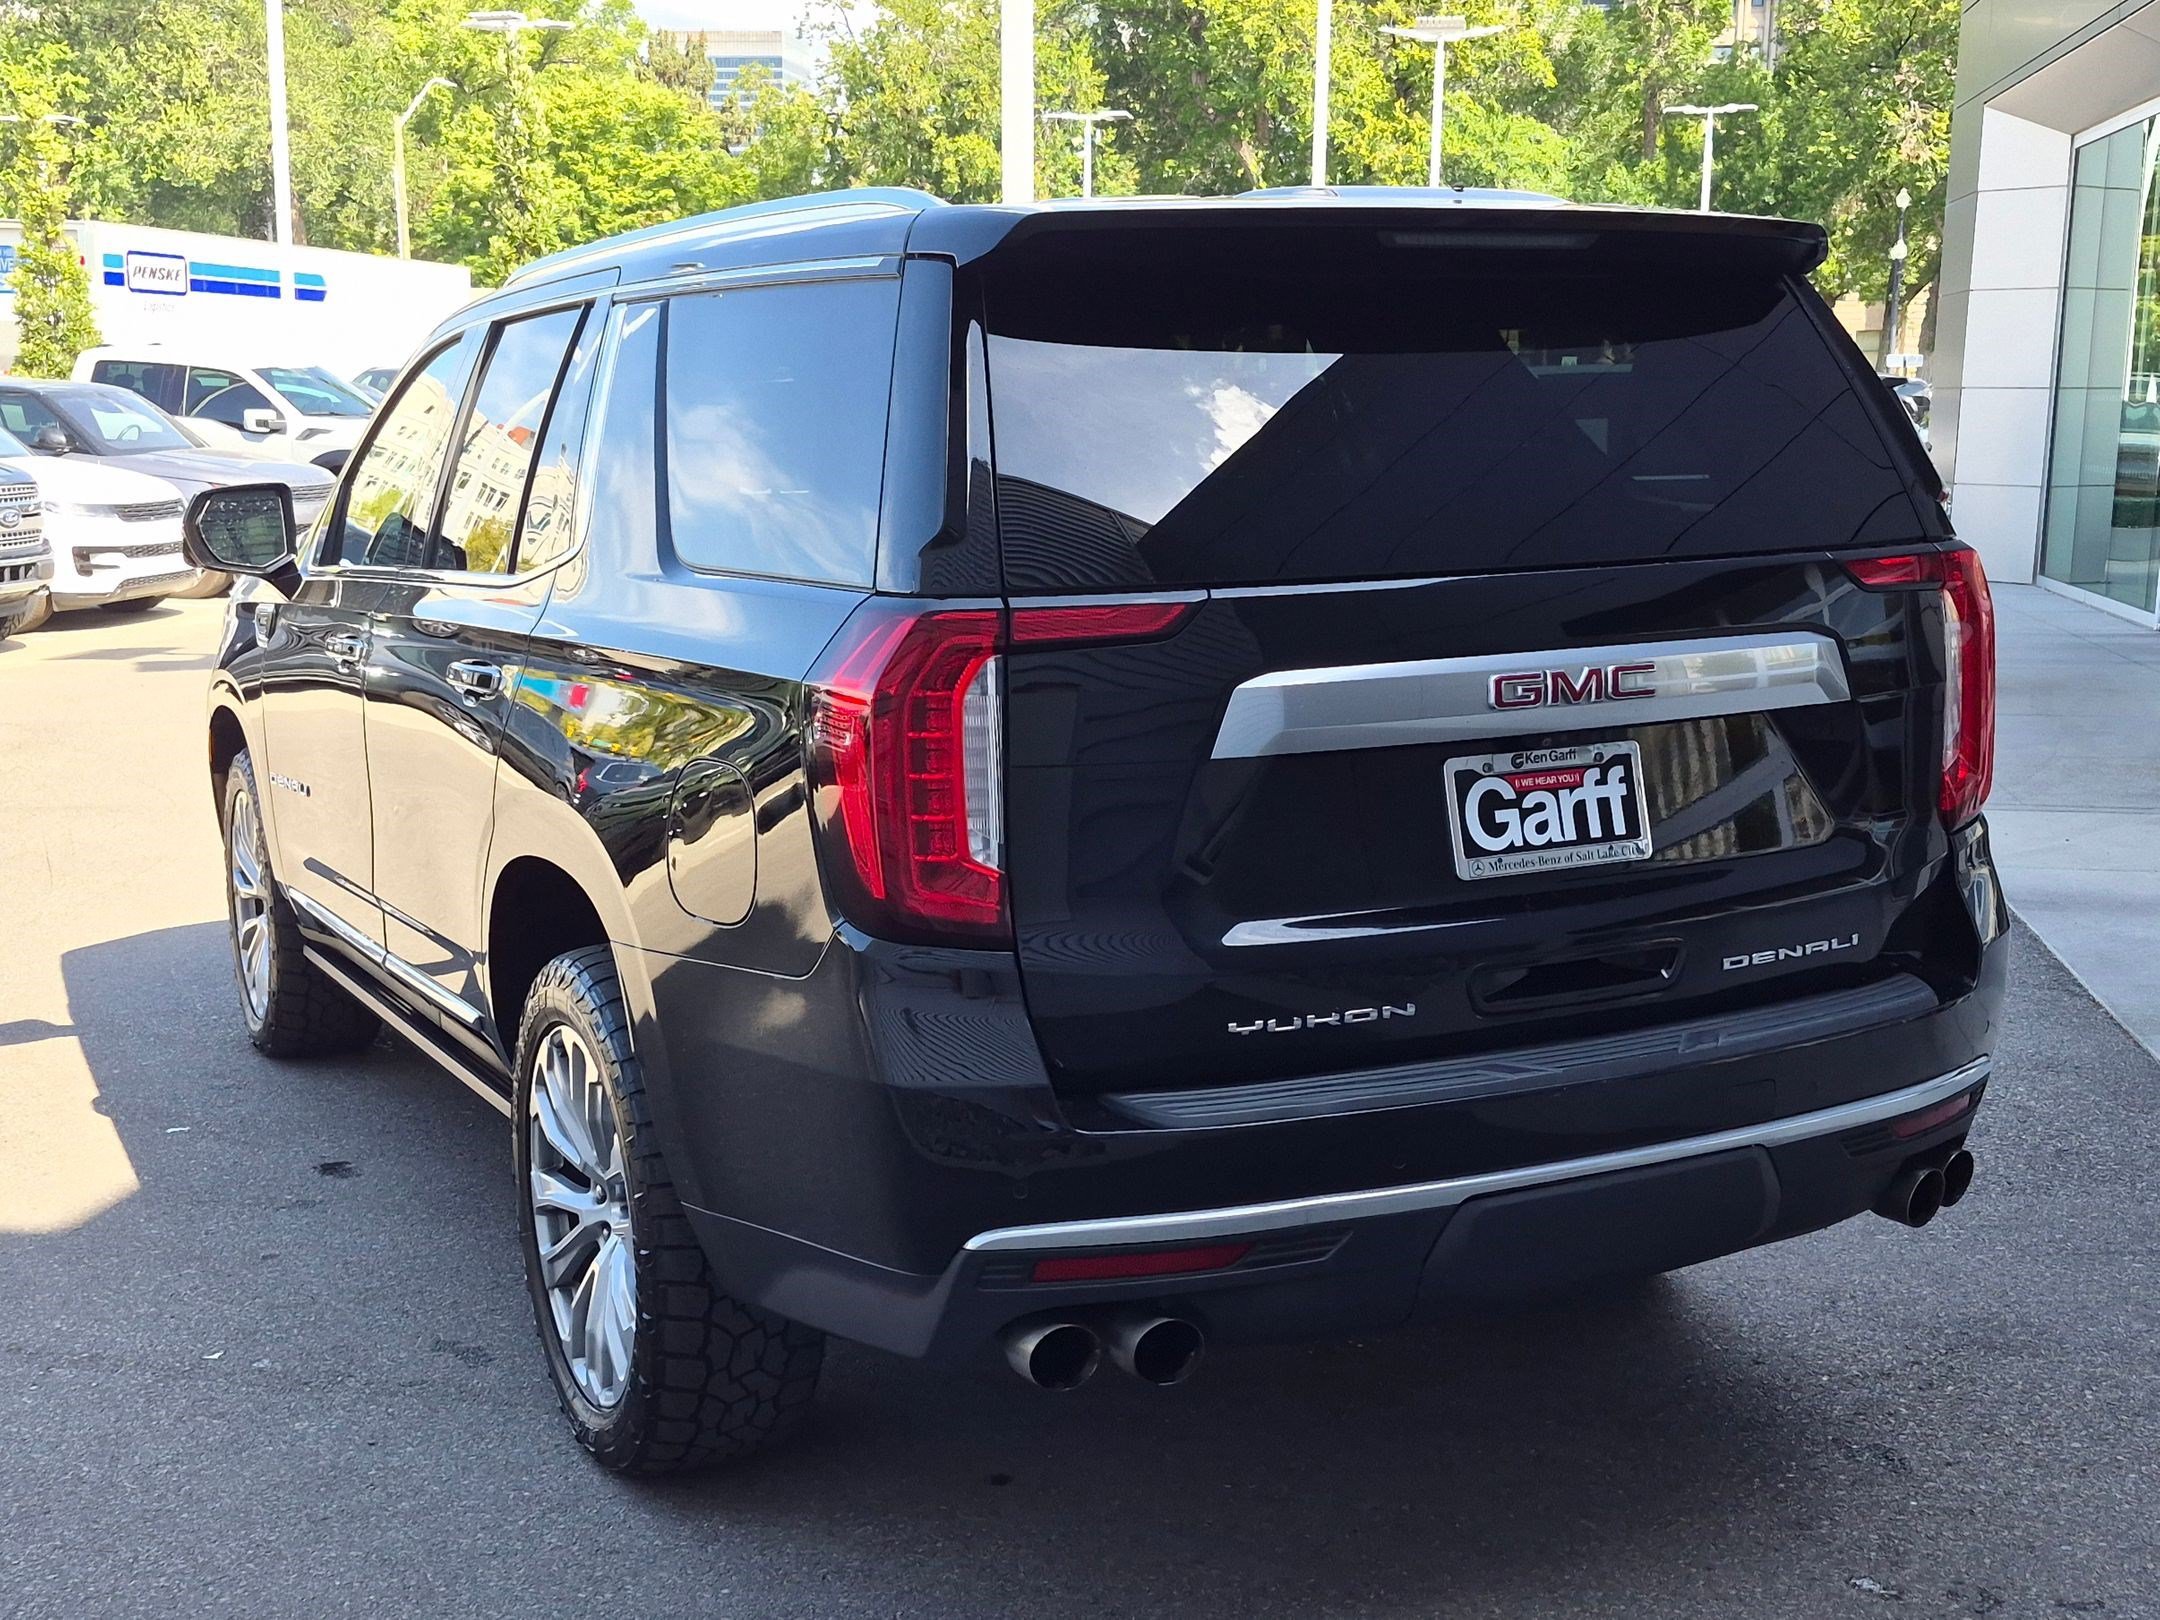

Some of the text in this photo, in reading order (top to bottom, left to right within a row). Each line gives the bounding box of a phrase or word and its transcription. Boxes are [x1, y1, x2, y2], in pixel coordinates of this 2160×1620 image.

[133, 266, 182, 281] PENSKE
[1488, 662, 1656, 711] GMC
[1525, 748, 1577, 765] Ken Garff
[1521, 774, 1575, 787] WE HEAR YOU
[1465, 765, 1628, 851] Garff
[1488, 856, 1562, 873] Mercedes-Benz
[1564, 851, 1573, 863] of
[1576, 850, 1594, 861] Salt
[1597, 846, 1619, 859] Lake
[1723, 933, 1859, 970] DENALI
[1228, 1003, 1415, 1035] YUKON
